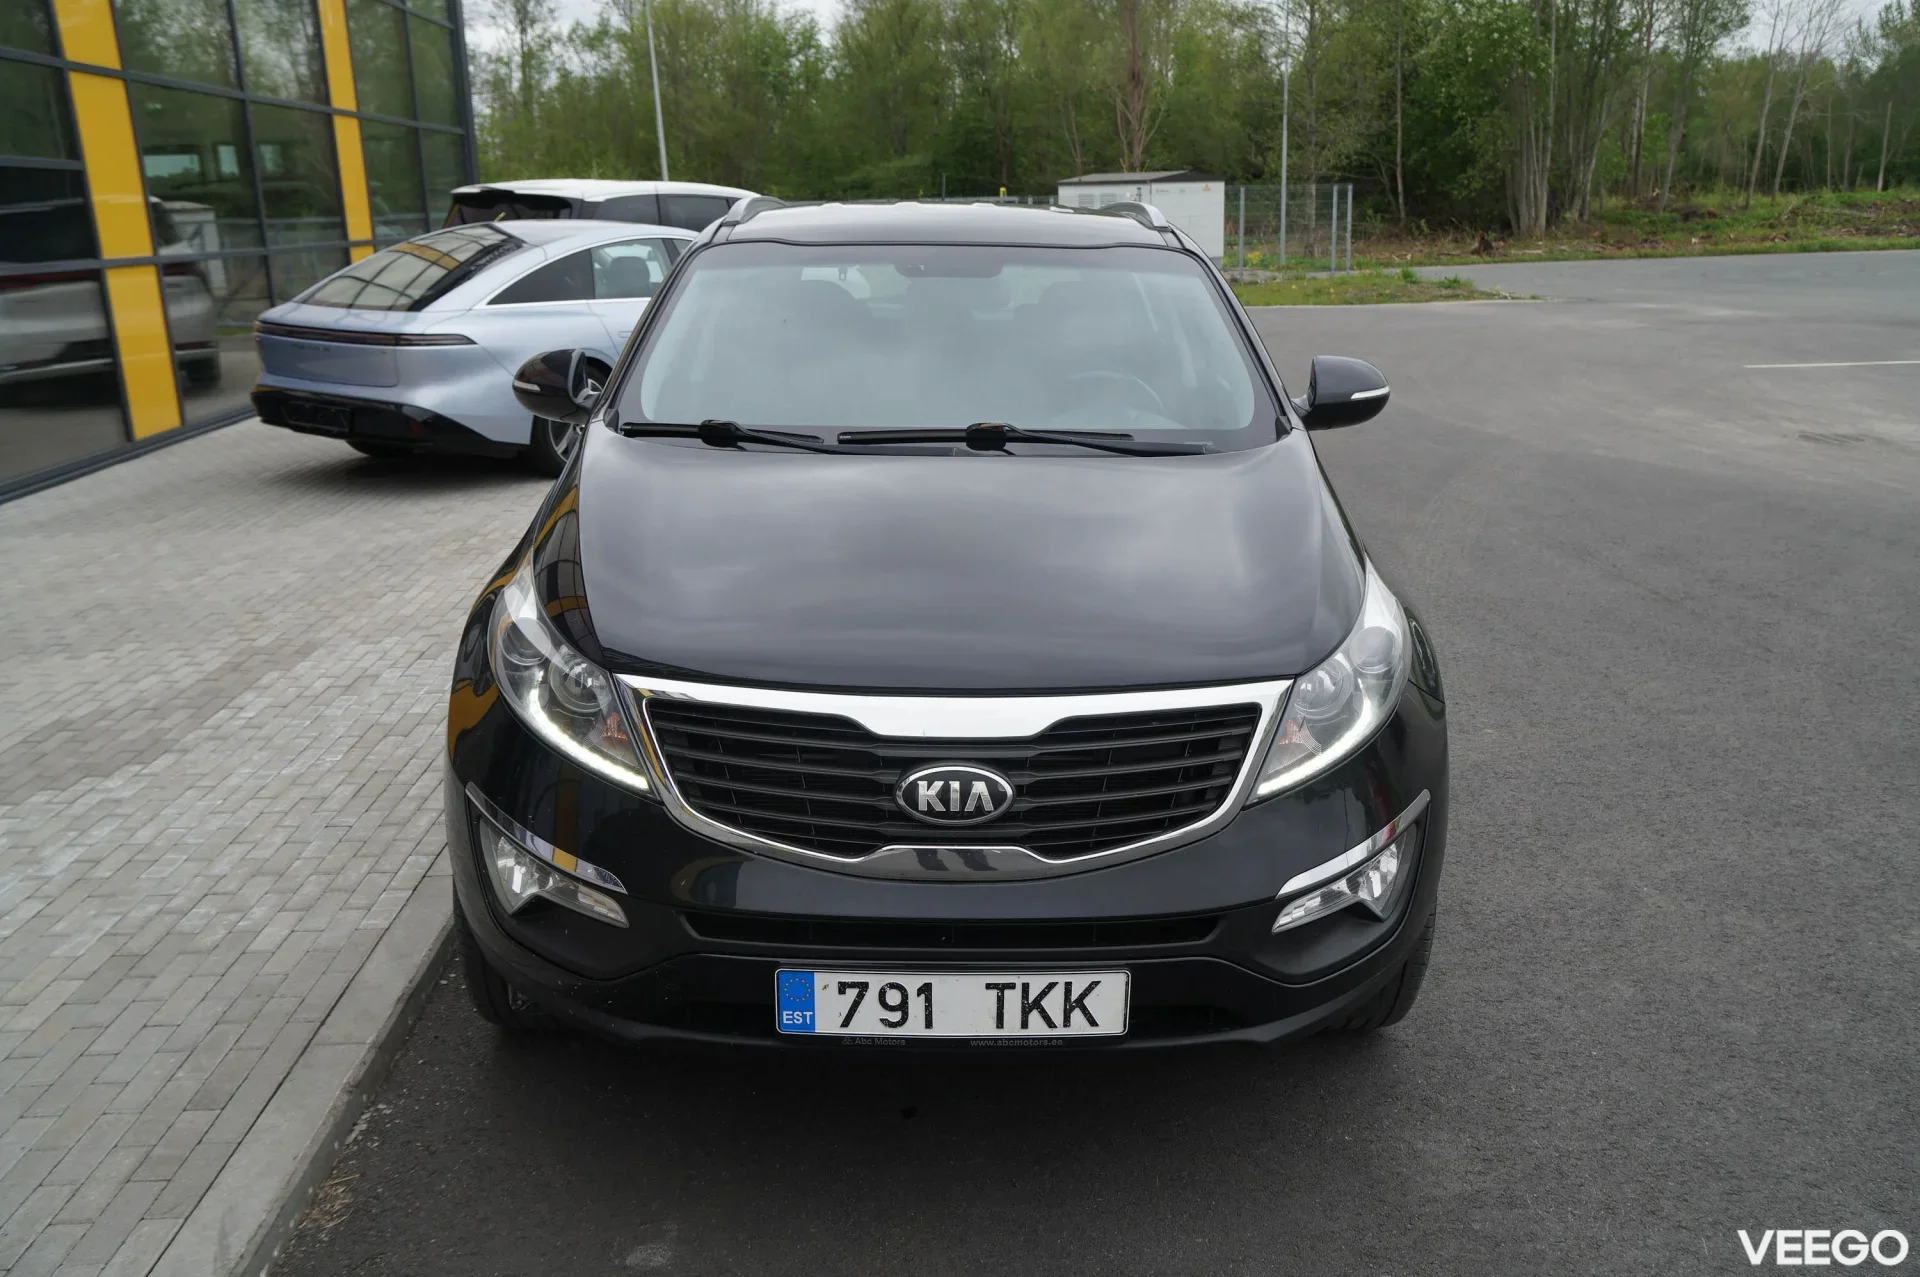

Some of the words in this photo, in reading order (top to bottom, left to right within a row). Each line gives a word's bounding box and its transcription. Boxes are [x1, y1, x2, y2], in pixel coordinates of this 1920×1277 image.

[917, 780, 994, 812] KIA
[837, 981, 933, 1029] 791
[985, 980, 1102, 1029] TKK
[782, 1011, 813, 1024] EST
[854, 1036, 873, 1045] Abc
[874, 1037, 906, 1046] Motors
[970, 1038, 1064, 1047] www.abcmotors.ee
